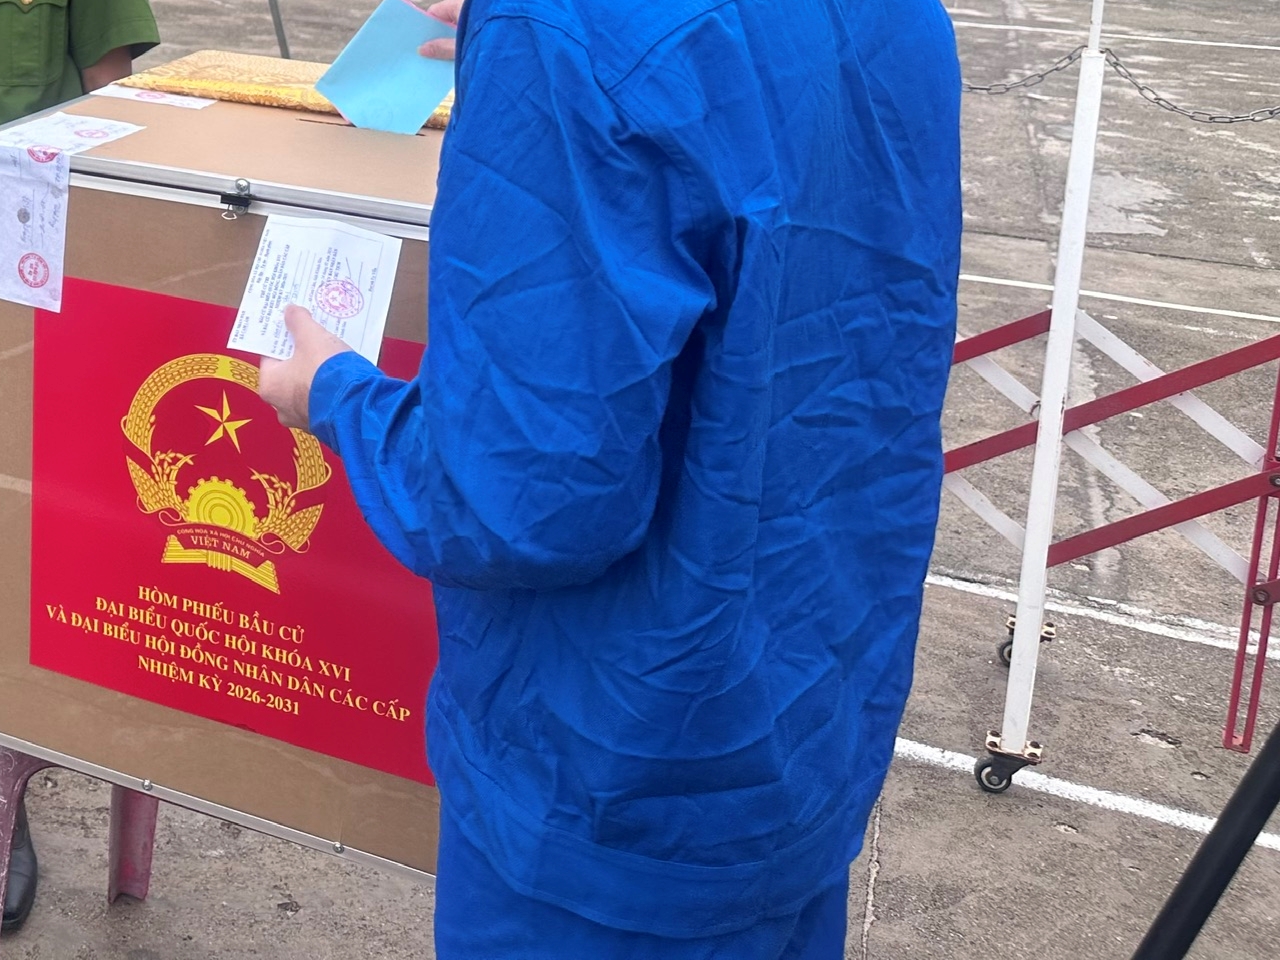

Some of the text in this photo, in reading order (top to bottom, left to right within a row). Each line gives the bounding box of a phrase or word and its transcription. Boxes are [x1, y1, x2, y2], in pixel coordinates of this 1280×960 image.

[190, 535, 251, 559] VIỆT NAM
[95, 596, 351, 682] ĐẠI BIỂU QUỐC HỘI KHÓA XVI
[138, 585, 305, 644] HÒM PHIẾU BẦU CỬ
[46, 604, 410, 722] VÀ ĐẠI BIỂU HỘI ĐỒNG NHÂN DÂN CÁC CẤP
[138, 655, 299, 715] NHIỆM KỲ 2026-2031
